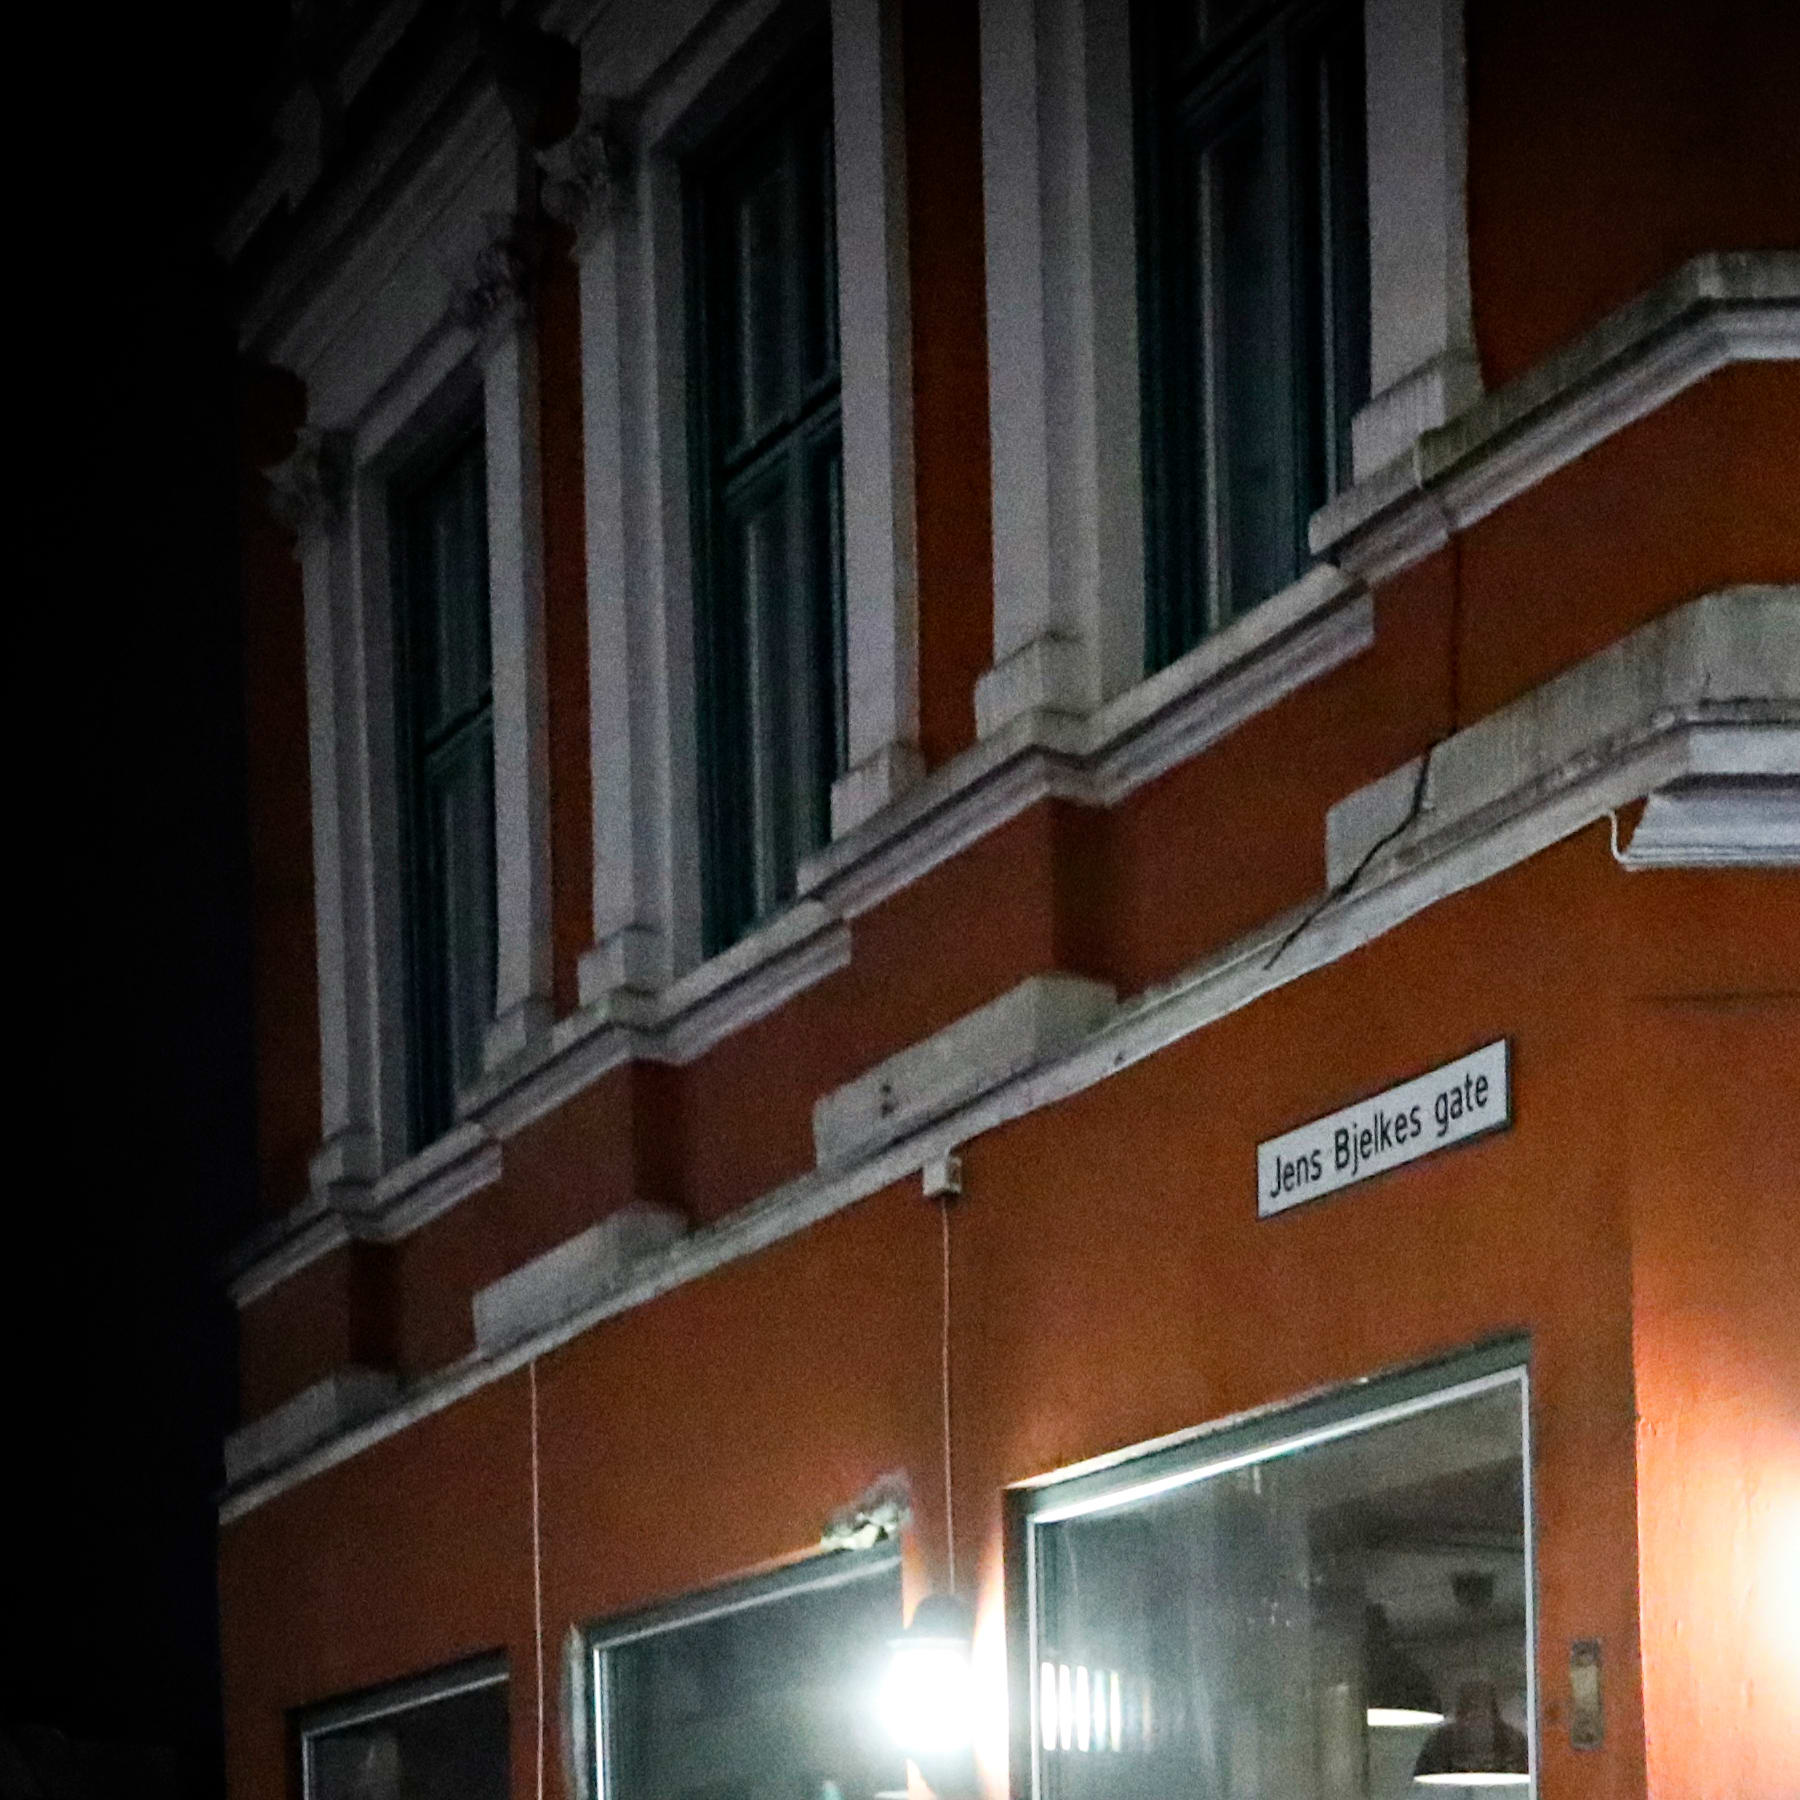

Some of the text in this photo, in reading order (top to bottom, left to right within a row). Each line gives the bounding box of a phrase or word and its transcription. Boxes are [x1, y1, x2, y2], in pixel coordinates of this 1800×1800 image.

[1269, 1072, 1489, 1198] Jens Bjelkes gate
